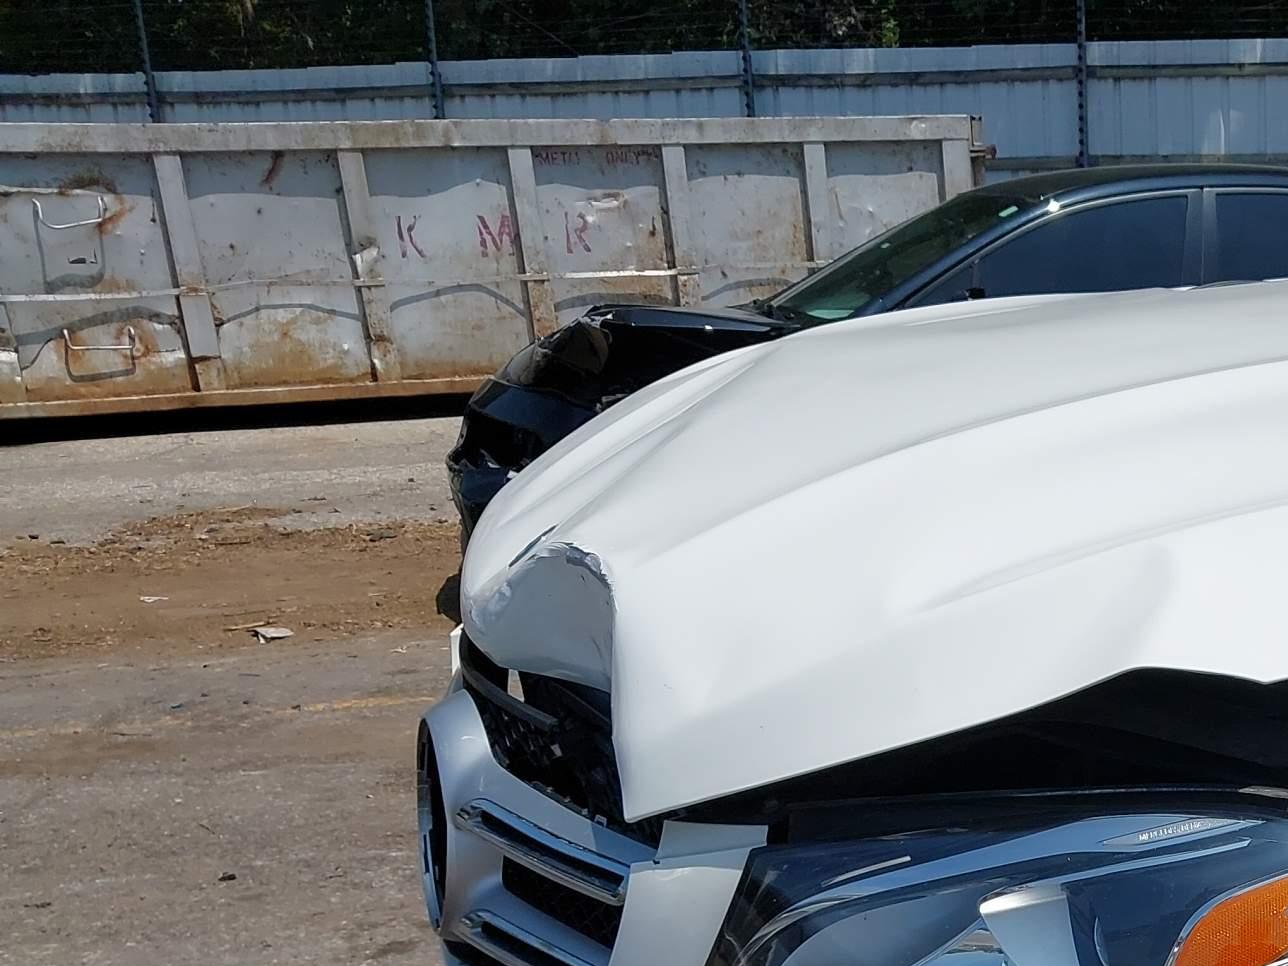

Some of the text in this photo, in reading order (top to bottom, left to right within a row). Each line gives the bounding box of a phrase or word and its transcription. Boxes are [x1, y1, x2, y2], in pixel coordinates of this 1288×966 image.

[395, 210, 593, 259] K M R
